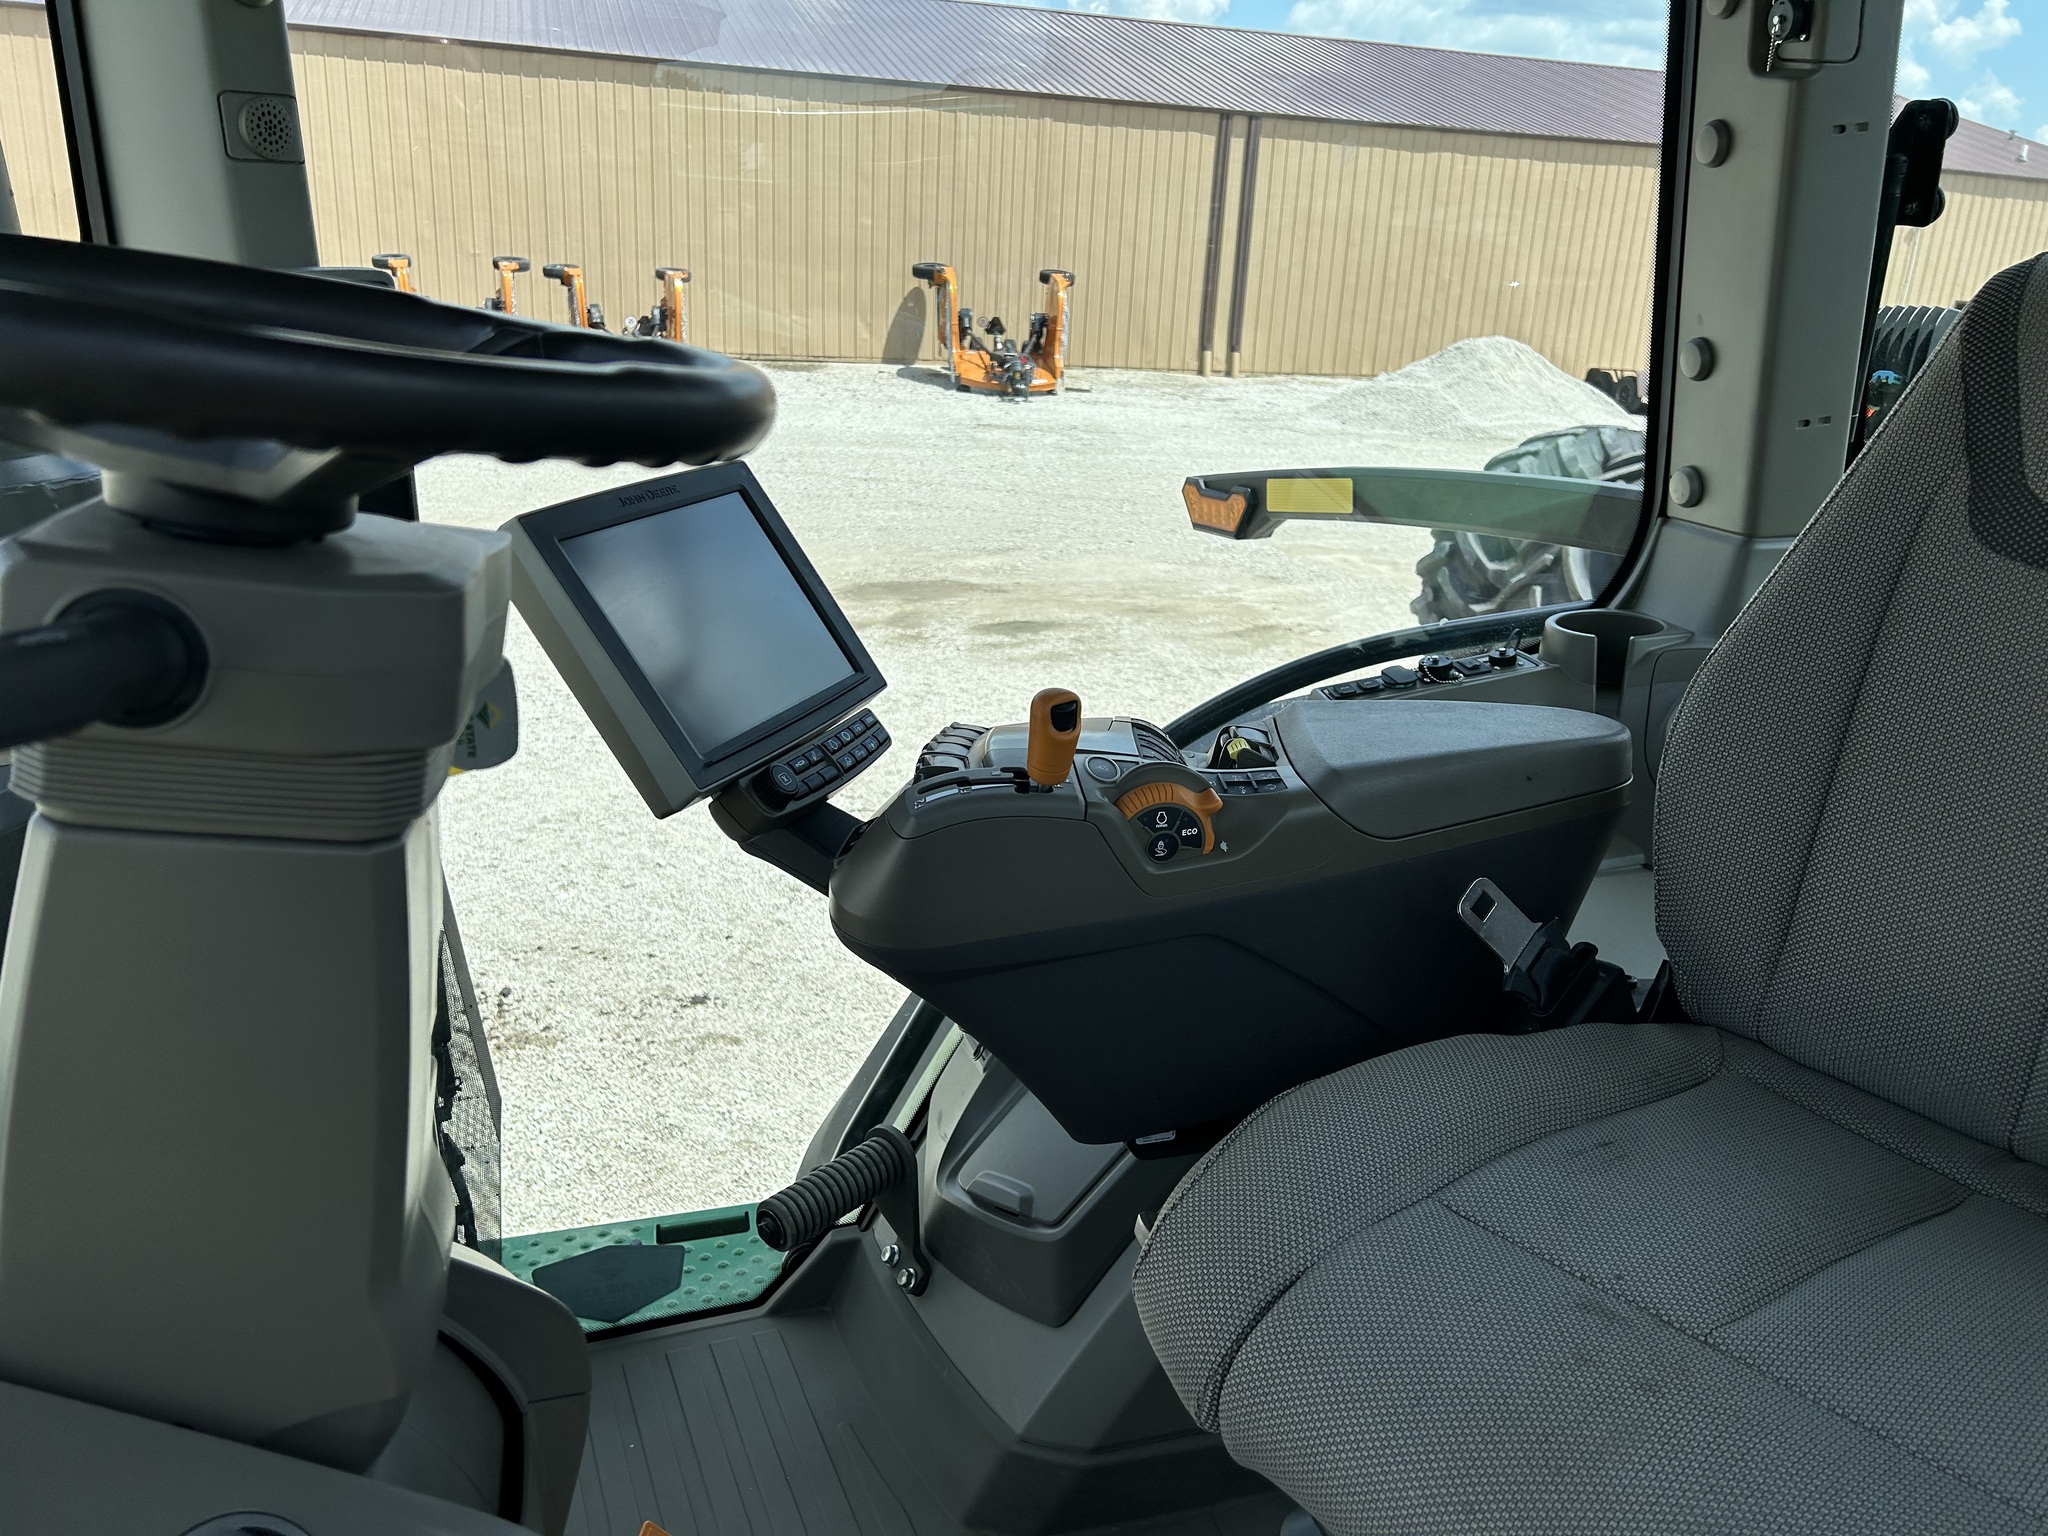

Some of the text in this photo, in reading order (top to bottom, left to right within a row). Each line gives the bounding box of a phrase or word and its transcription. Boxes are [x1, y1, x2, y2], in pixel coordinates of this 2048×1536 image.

[618, 484, 681, 508] JOHN DEERE
[1181, 827, 1198, 836] ECO
